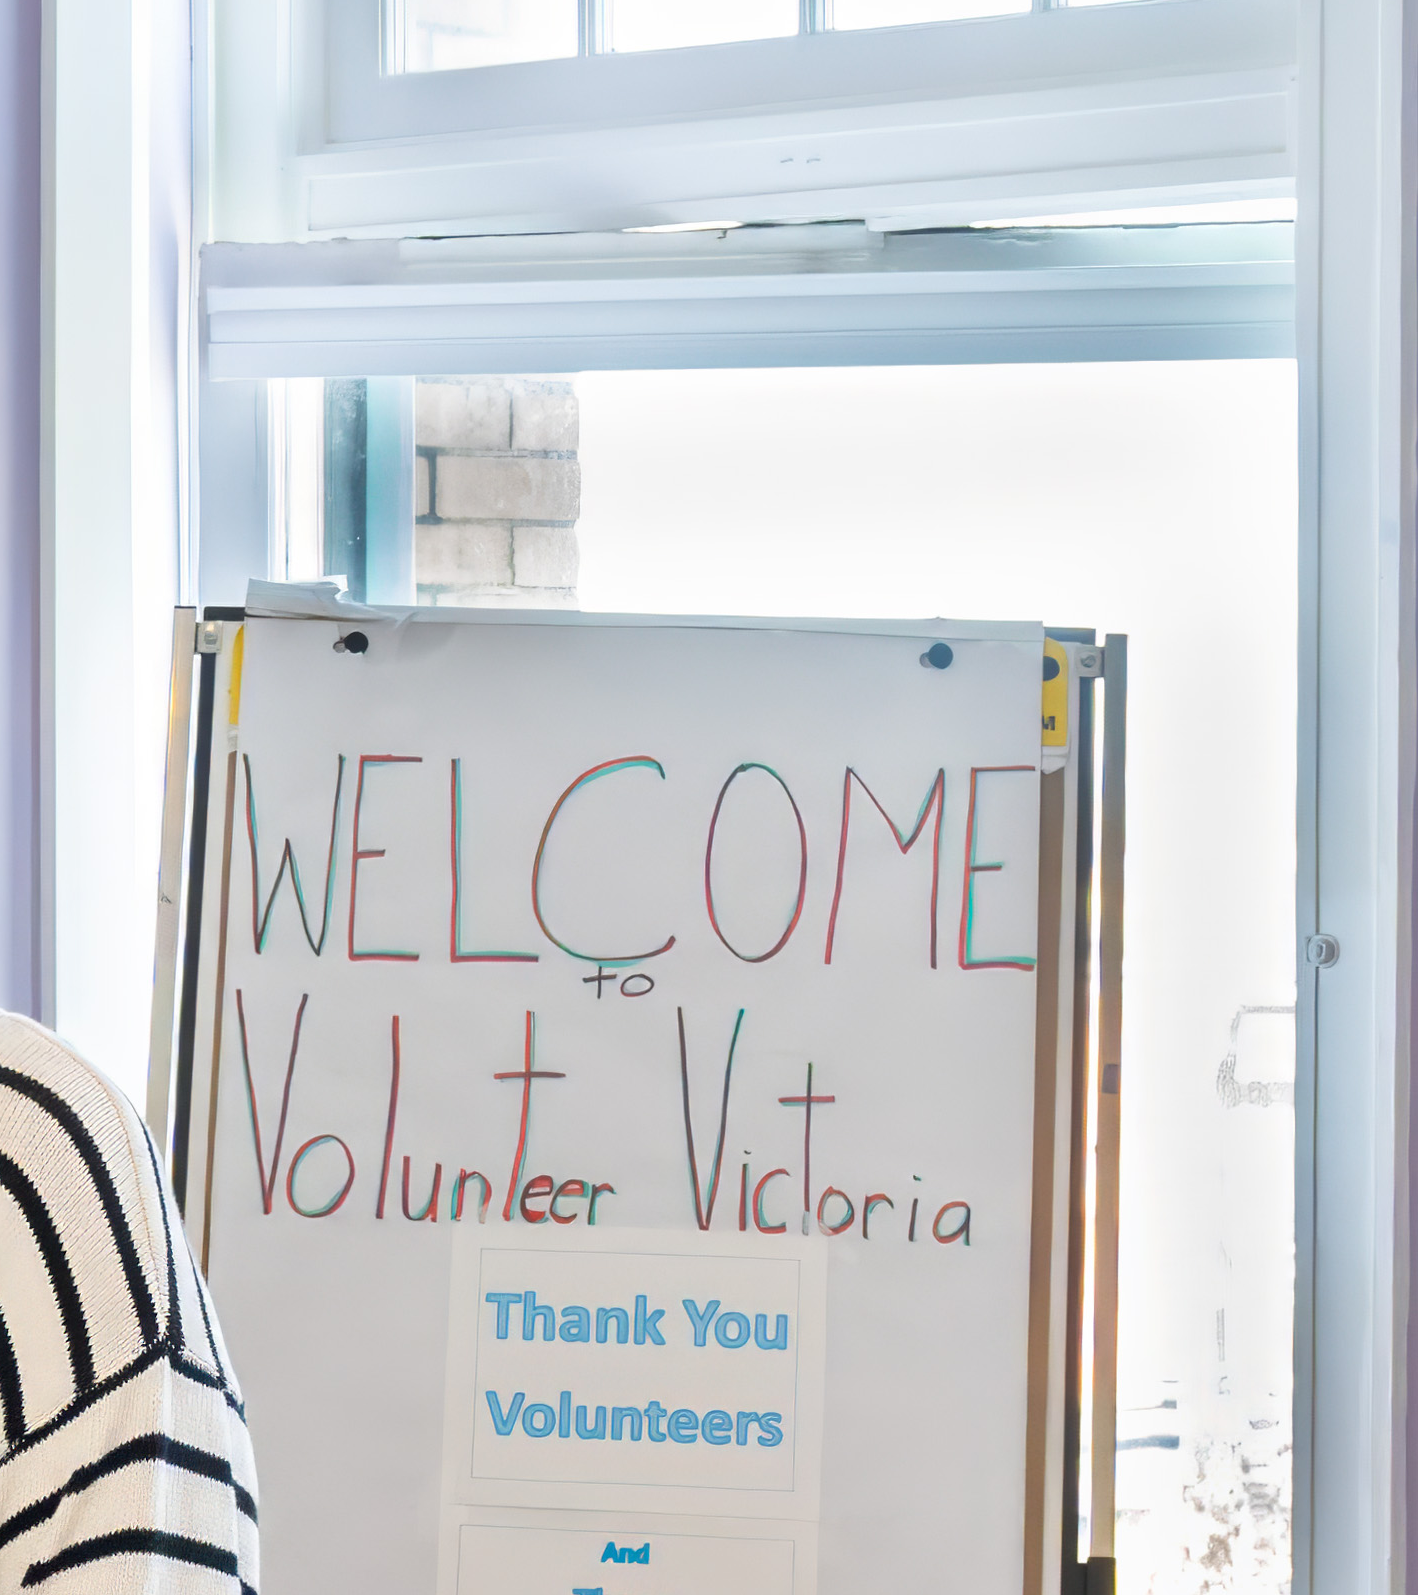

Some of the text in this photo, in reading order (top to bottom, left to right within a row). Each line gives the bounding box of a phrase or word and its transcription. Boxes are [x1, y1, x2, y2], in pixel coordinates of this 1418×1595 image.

[241, 752, 1038, 972] WELCOME
[235, 989, 972, 1246] Volunteer Victoria
[486, 1291, 788, 1350] Thank You
[485, 1390, 784, 1447] Volunteers
[601, 1542, 650, 1565] And
